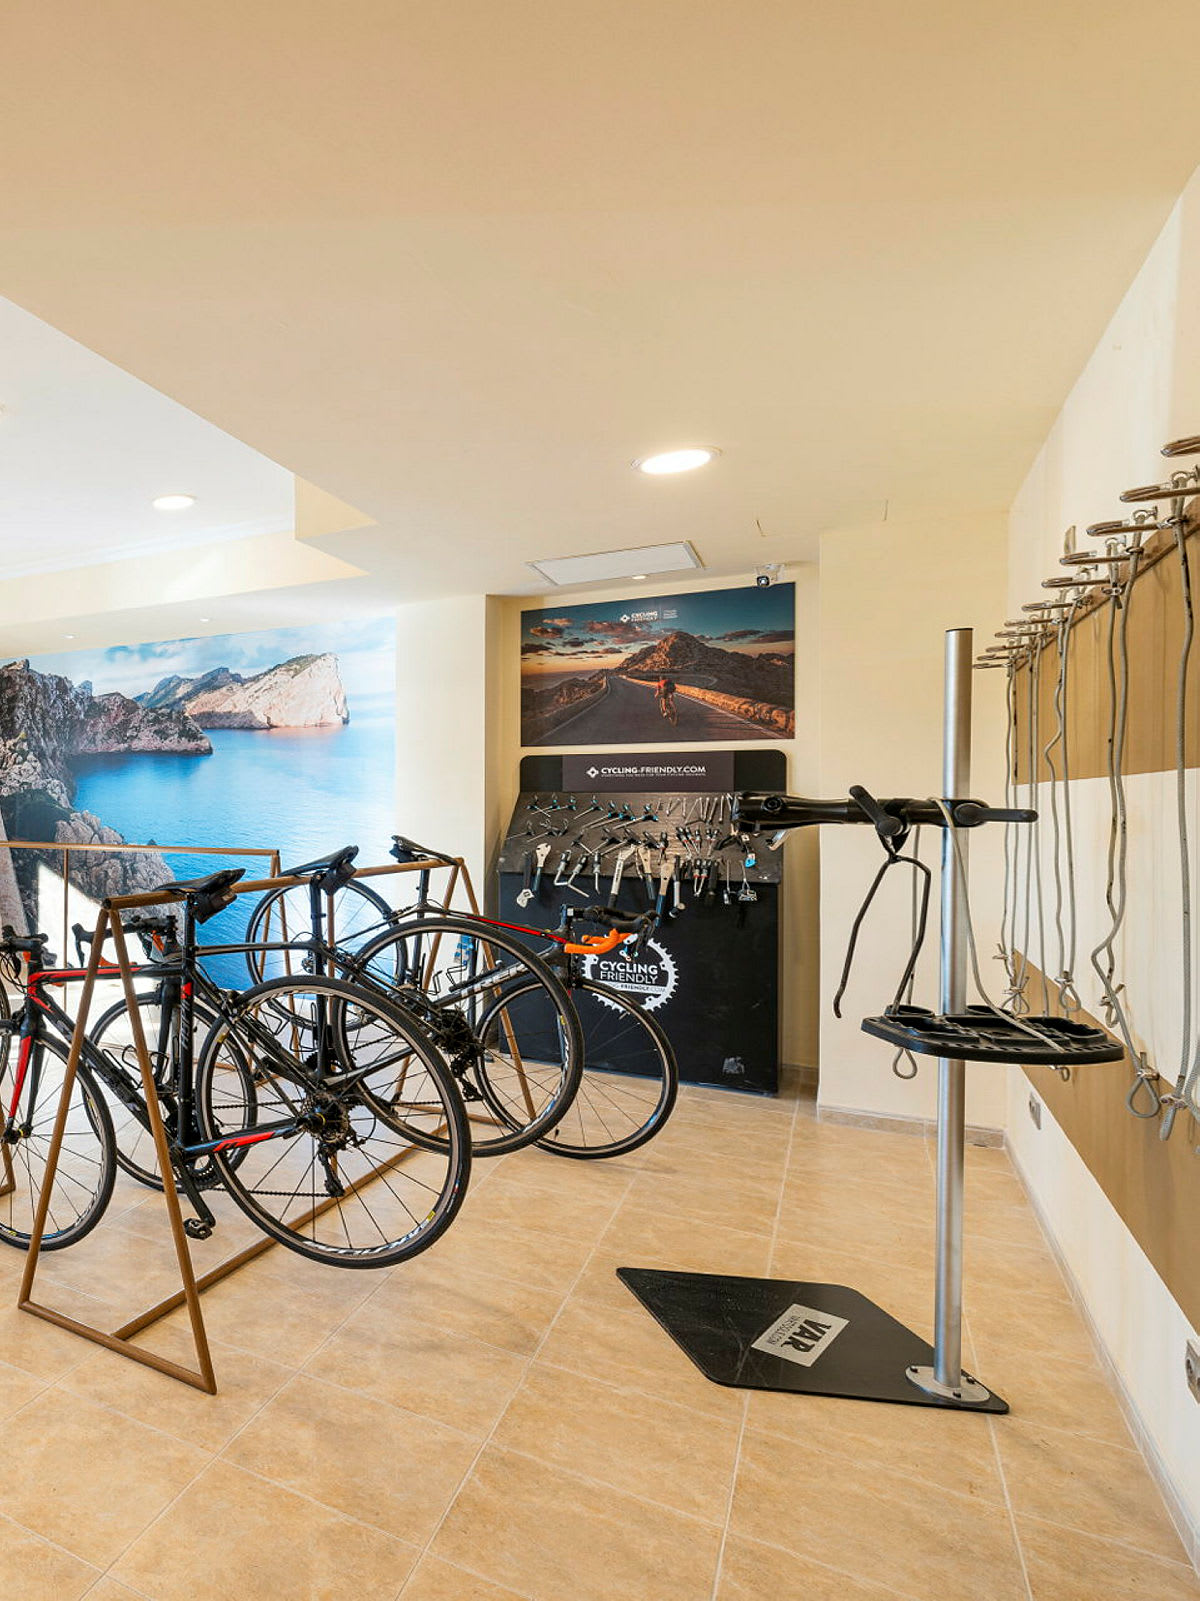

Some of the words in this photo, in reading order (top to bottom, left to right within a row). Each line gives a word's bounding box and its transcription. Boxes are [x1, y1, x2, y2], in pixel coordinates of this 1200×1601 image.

[601, 766, 706, 775] CYCLING-FRIENDLY.COM
[600, 961, 658, 975] CYCLING
[601, 971, 658, 984] FRIENDLY
[781, 1319, 832, 1353] VAR
